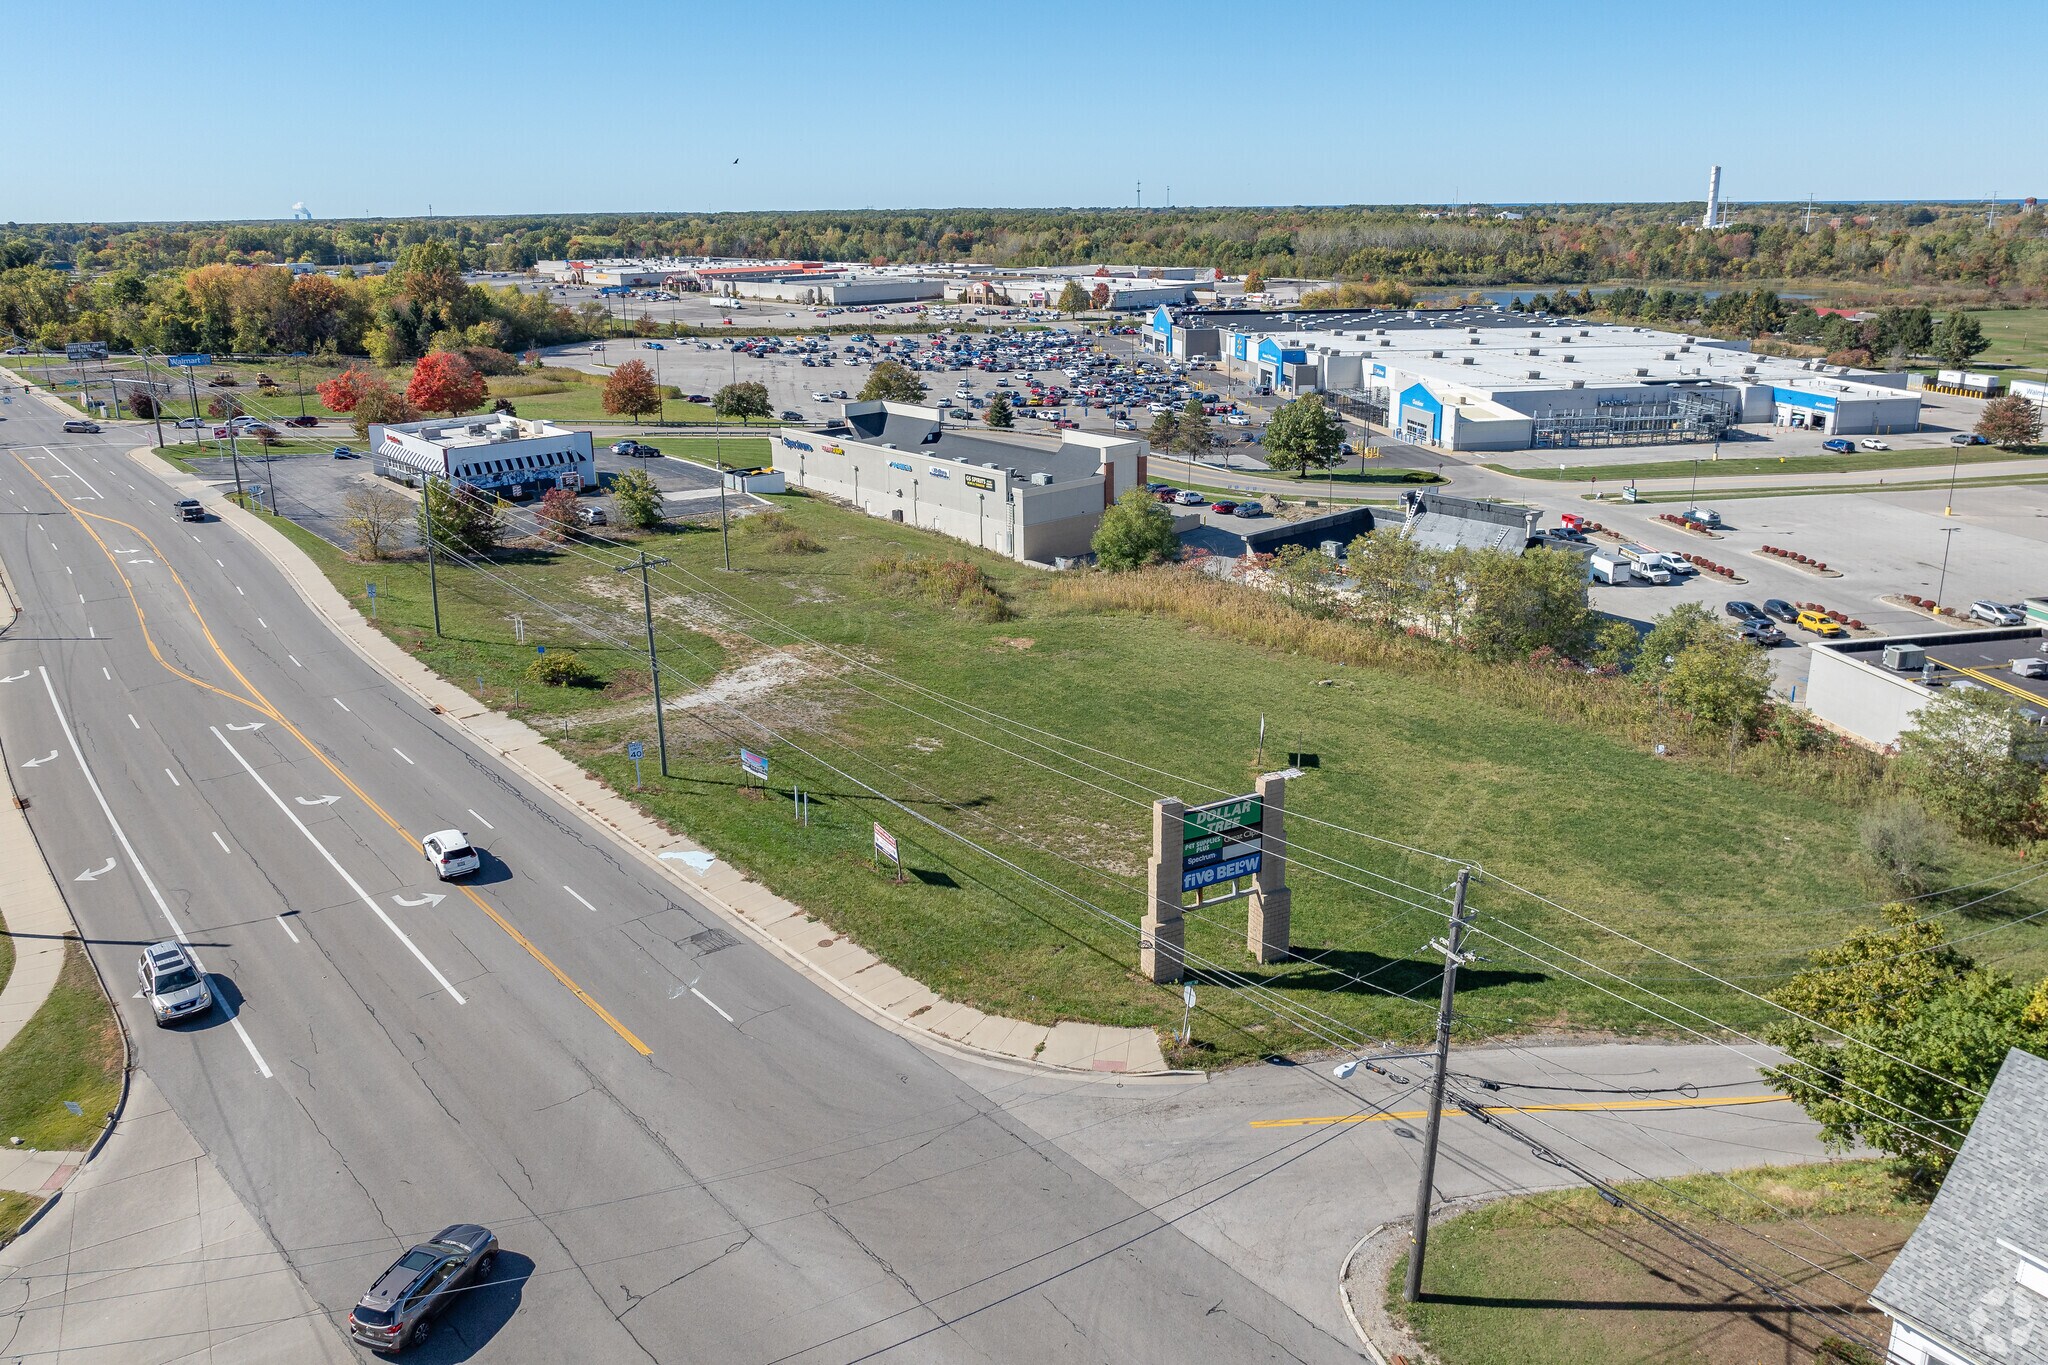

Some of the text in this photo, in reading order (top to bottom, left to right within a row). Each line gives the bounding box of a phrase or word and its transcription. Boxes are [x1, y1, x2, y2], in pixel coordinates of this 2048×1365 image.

[169, 357, 201, 366] Walmart
[1196, 802, 1251, 824] DOLLAR
[1206, 816, 1241, 834] TREE
[1184, 836, 1221, 851] PET SUPPLIES
[1196, 844, 1210, 853] PLUS
[1187, 852, 1216, 865] Spectrum
[1183, 857, 1259, 888] five BELOW
